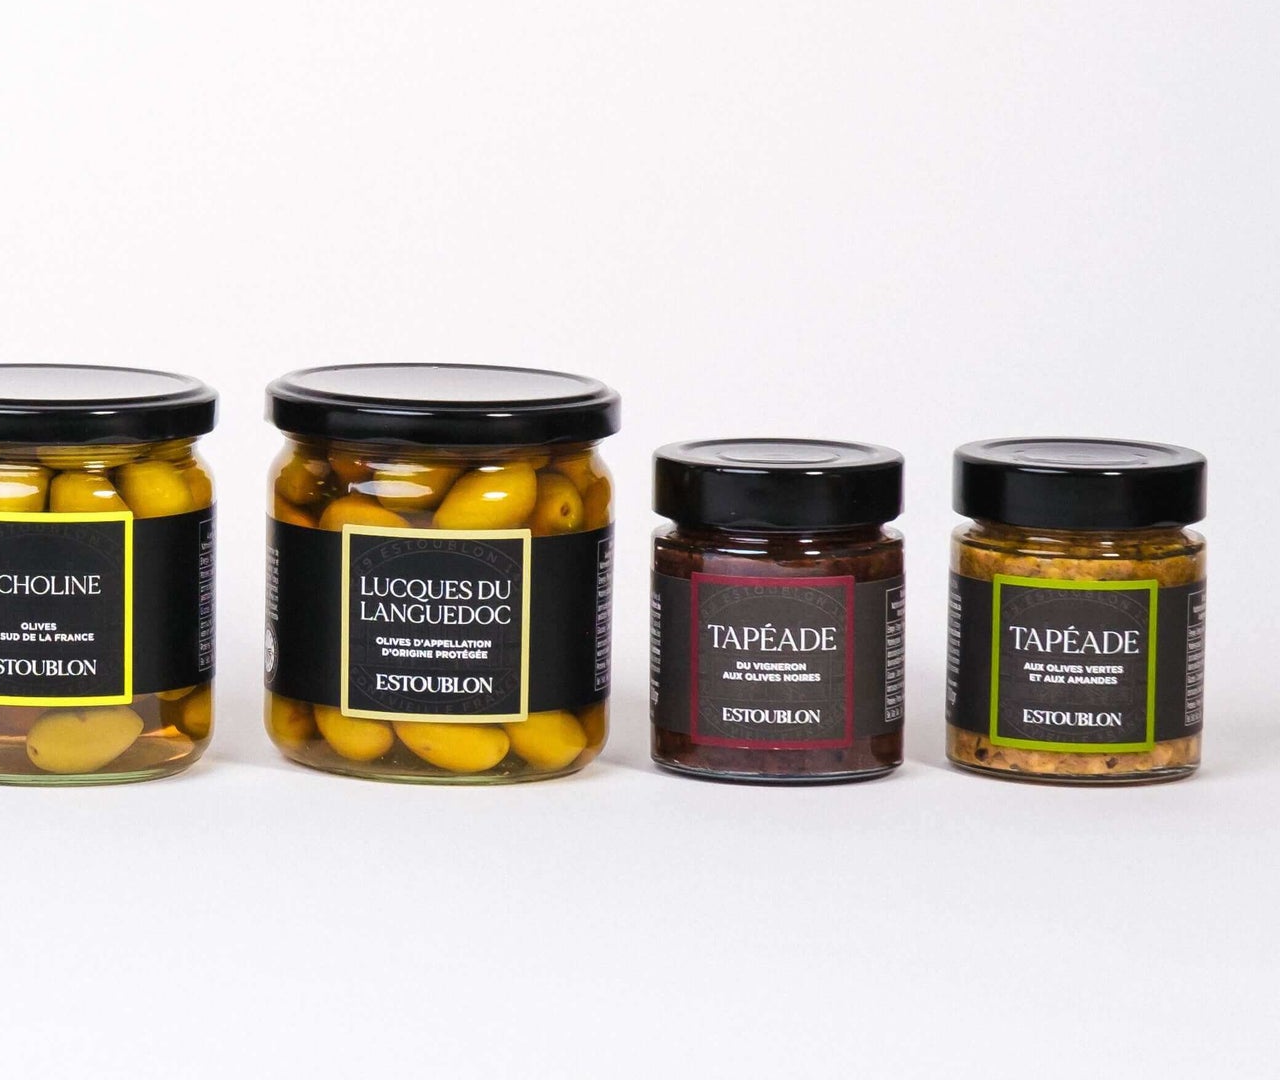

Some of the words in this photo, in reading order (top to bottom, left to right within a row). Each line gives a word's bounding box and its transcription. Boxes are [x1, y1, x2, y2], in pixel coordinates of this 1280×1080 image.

[360, 576, 472, 602] LUCQUES
[478, 580, 511, 600] DU
[360, 601, 511, 625] LANGUEDOC
[21, 622, 57, 631] OLIVES
[0, 633, 19, 641] SUD
[23, 633, 36, 641] DE
[55, 633, 94, 641] FRANCE
[376, 637, 411, 647] OLIVES
[414, 639, 492, 648] D'APPELLATION
[708, 623, 837, 652] TAPÉADE
[1009, 626, 1140, 654] TAPÉADE
[382, 648, 433, 658] D'ORIGINE
[436, 649, 488, 659] PROTÉGÉE
[736, 661, 751, 670] DU
[753, 662, 807, 671] VIGNERON
[1024, 662, 1044, 671] AUX
[1046, 664, 1083, 673] OLIVES
[1085, 665, 1124, 673] VERTES
[722, 672, 743, 680] AUX
[745, 673, 781, 682] OLIVES
[784, 673, 821, 682] NOIRES
[1044, 675, 1065, 683] AUX
[1067, 675, 1118, 684] AMANDES
[376, 673, 493, 694] ESTOUBLON
[722, 707, 821, 724] ESTOUBLON
[1023, 709, 1122, 727] ESTOUBLON
